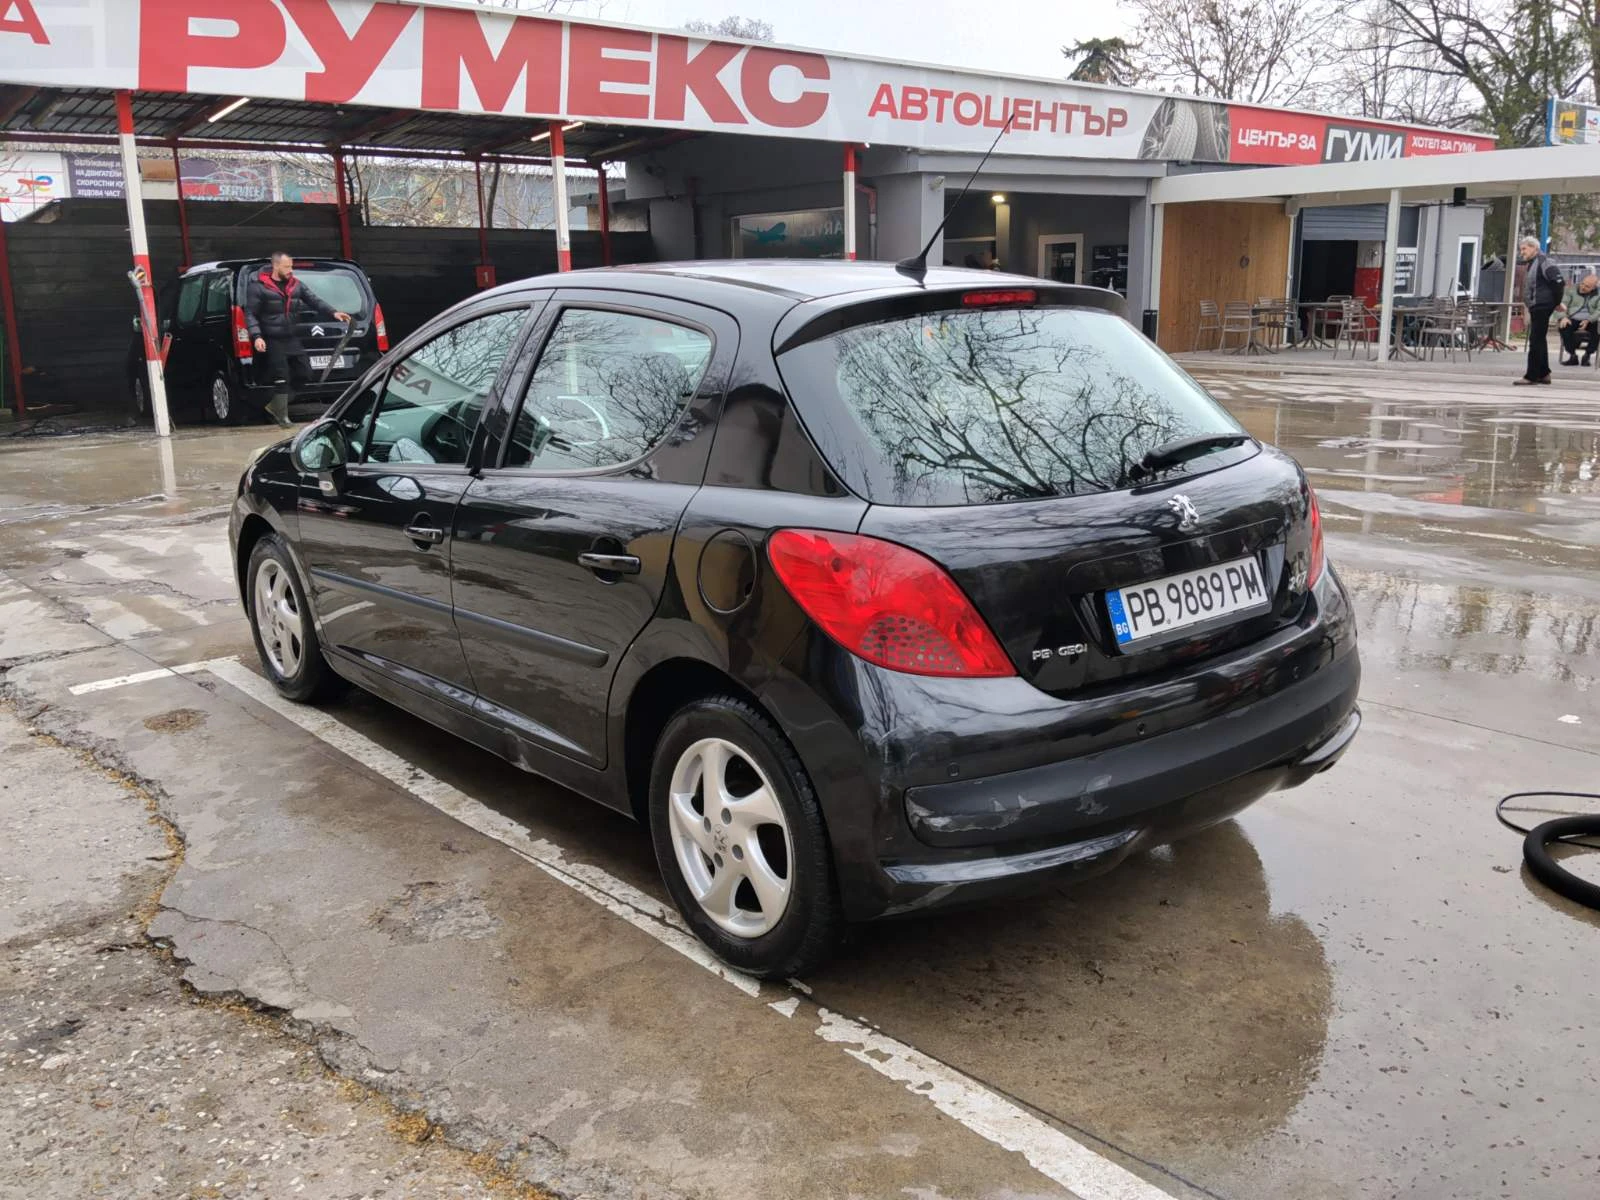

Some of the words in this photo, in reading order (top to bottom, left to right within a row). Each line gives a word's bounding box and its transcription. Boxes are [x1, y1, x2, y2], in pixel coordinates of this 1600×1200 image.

[138, 0, 830, 128] РУМЕКС
[868, 83, 1129, 137] АВТОЦЕНТЪР
[1237, 128, 1297, 148] ЦЕНТЪР
[1299, 134, 1317, 150] ЗА
[1325, 128, 1403, 161] ГУМИ
[1115, 622, 1129, 636] BG
[1032, 643, 1088, 661] PEGEO
